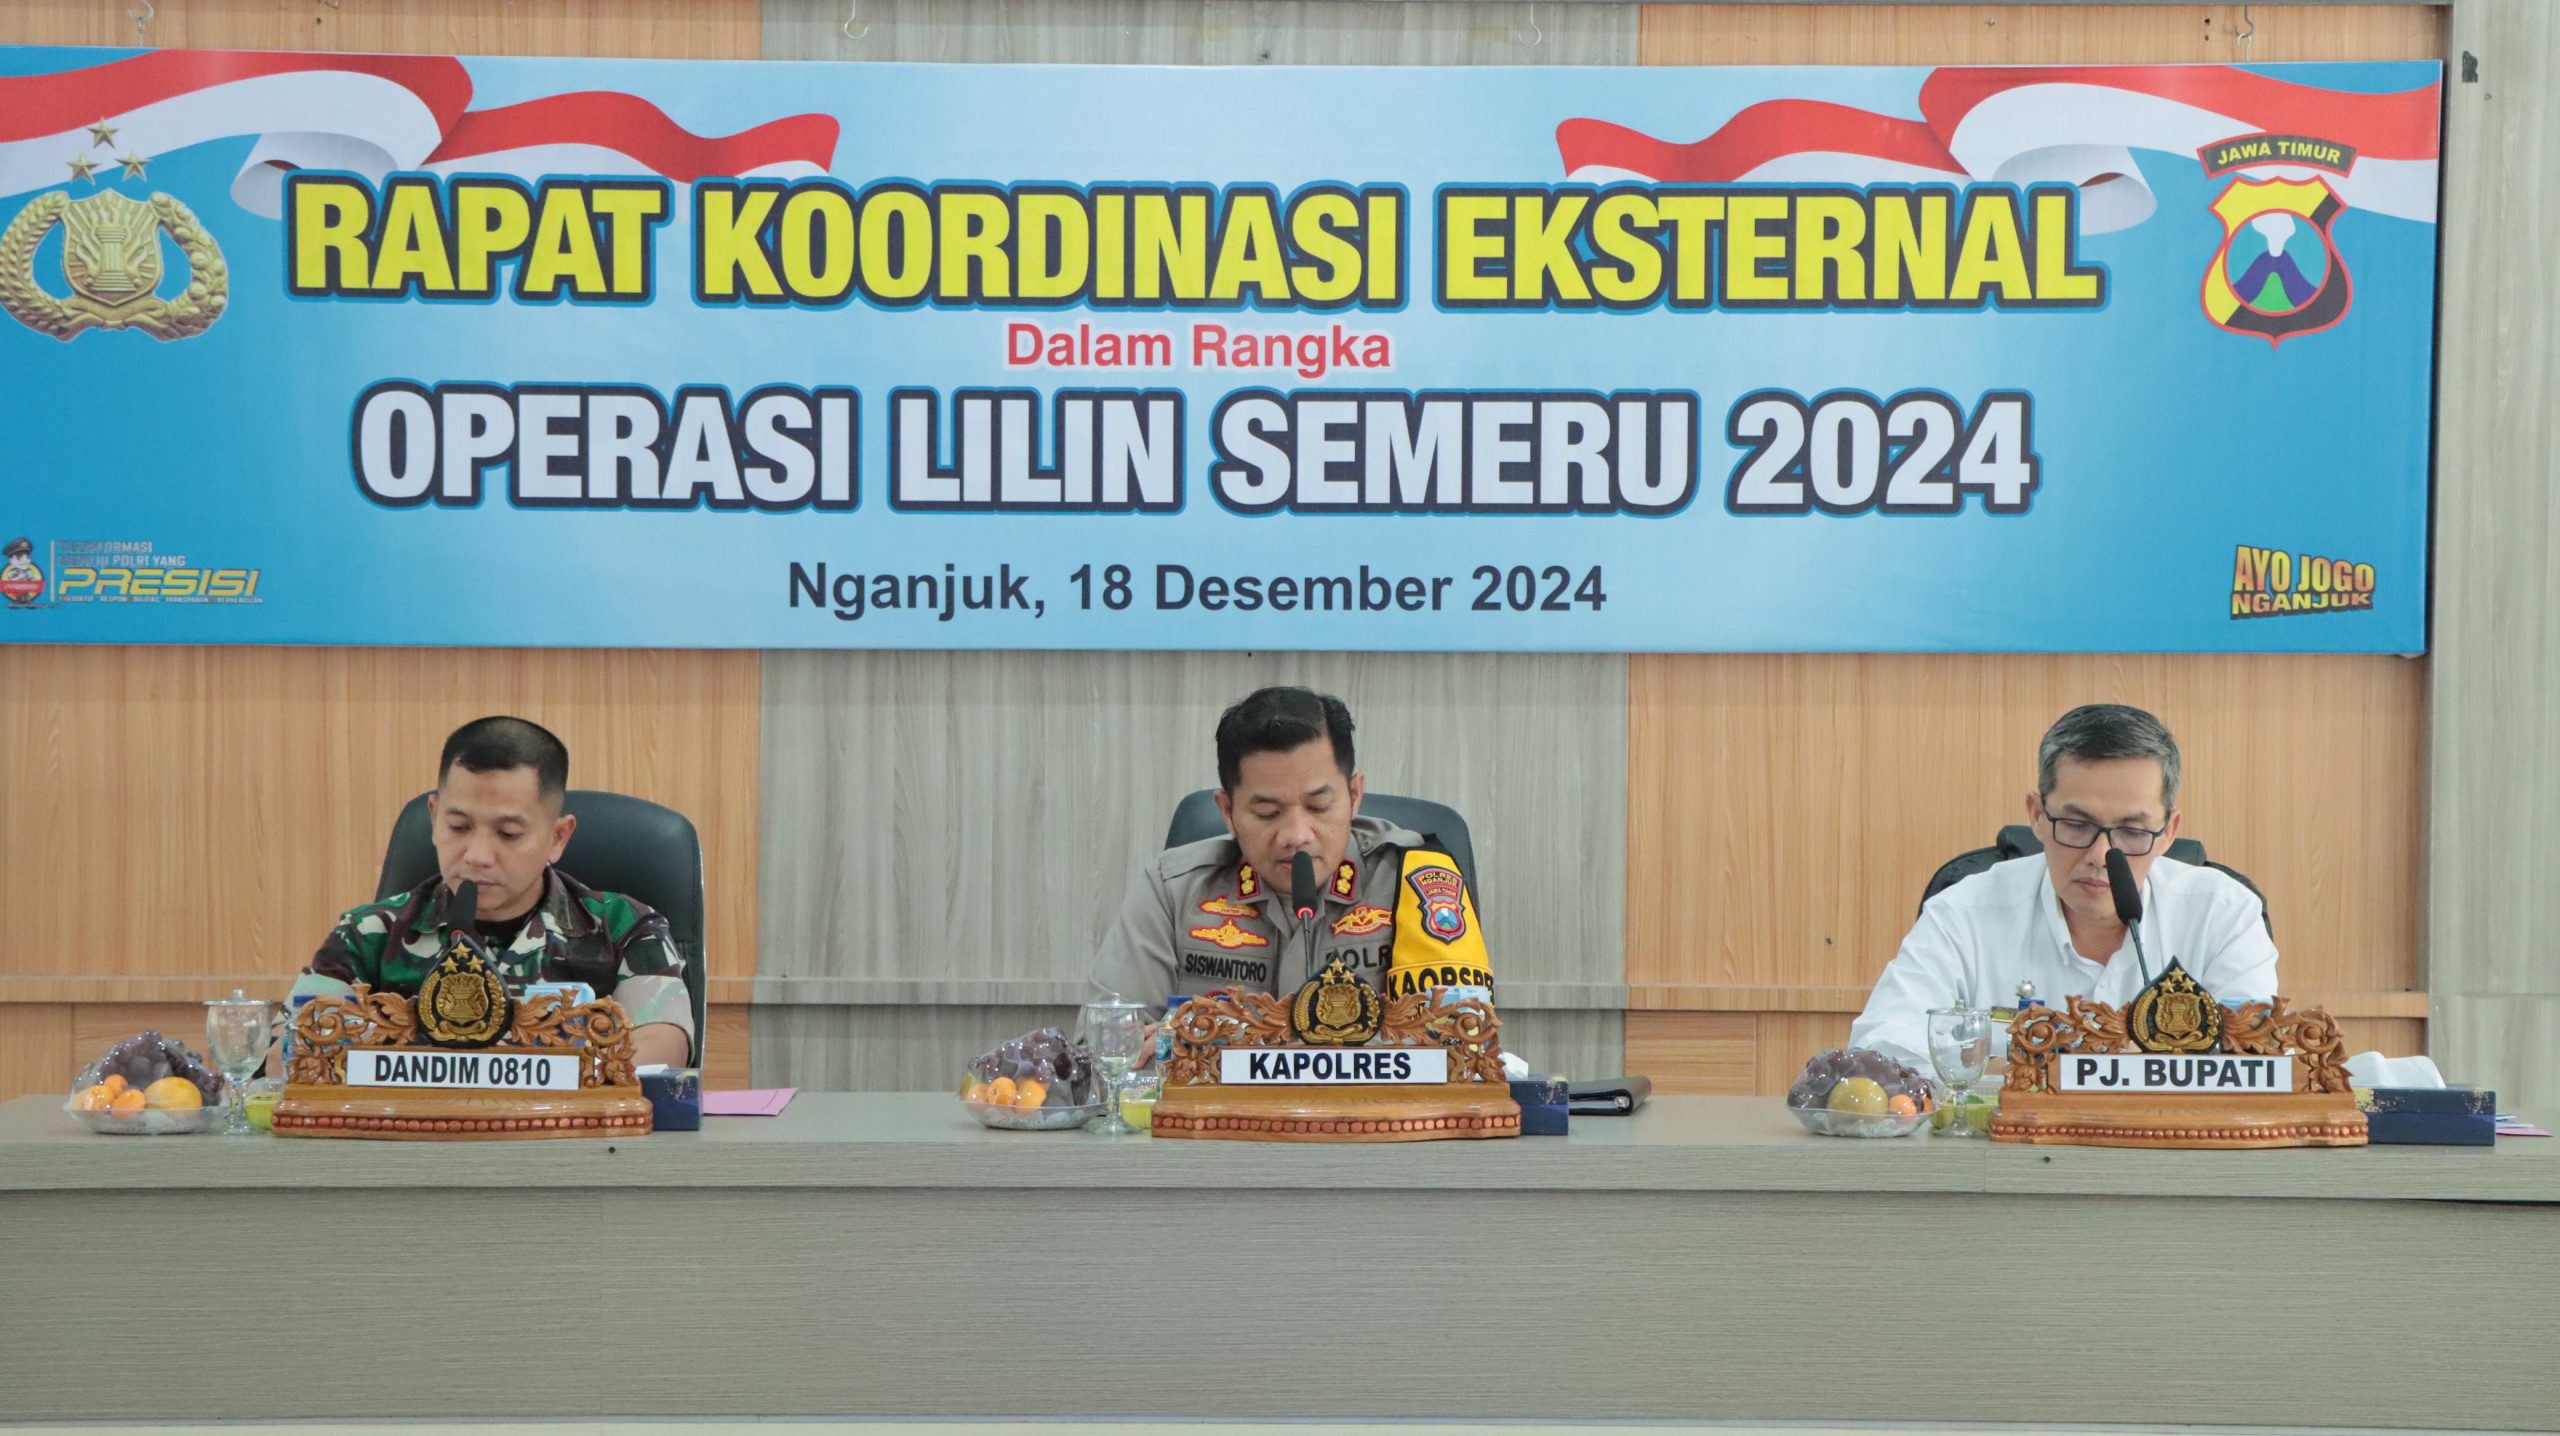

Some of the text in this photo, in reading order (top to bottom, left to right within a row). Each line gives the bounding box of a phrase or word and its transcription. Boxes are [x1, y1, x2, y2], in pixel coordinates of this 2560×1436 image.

[2216, 140, 2342, 165] JAWA TIMUR
[291, 181, 2102, 306] RAPAT KOORDINASI EKSTERNAL
[1007, 323, 1391, 380] Dalam Rangka
[357, 388, 2034, 509] OPERASI LILIN SEMERU 2024
[112, 555, 149, 567] POLRI
[153, 555, 186, 567] YANG
[2232, 544, 2376, 594] AYO JOGO
[58, 567, 261, 597] PRESISI
[788, 561, 1608, 622] Nganjuk, 18 Desember 2024
[2230, 592, 2374, 620] NGANJUK
[1418, 872, 1458, 884] POLRES
[1184, 953, 1267, 983] SISWANTORO
[374, 1054, 551, 1087] DANDIM 0810
[1249, 1052, 1412, 1080] KAPOLRES
[2075, 1057, 2276, 1088] PJ. BUPATI
